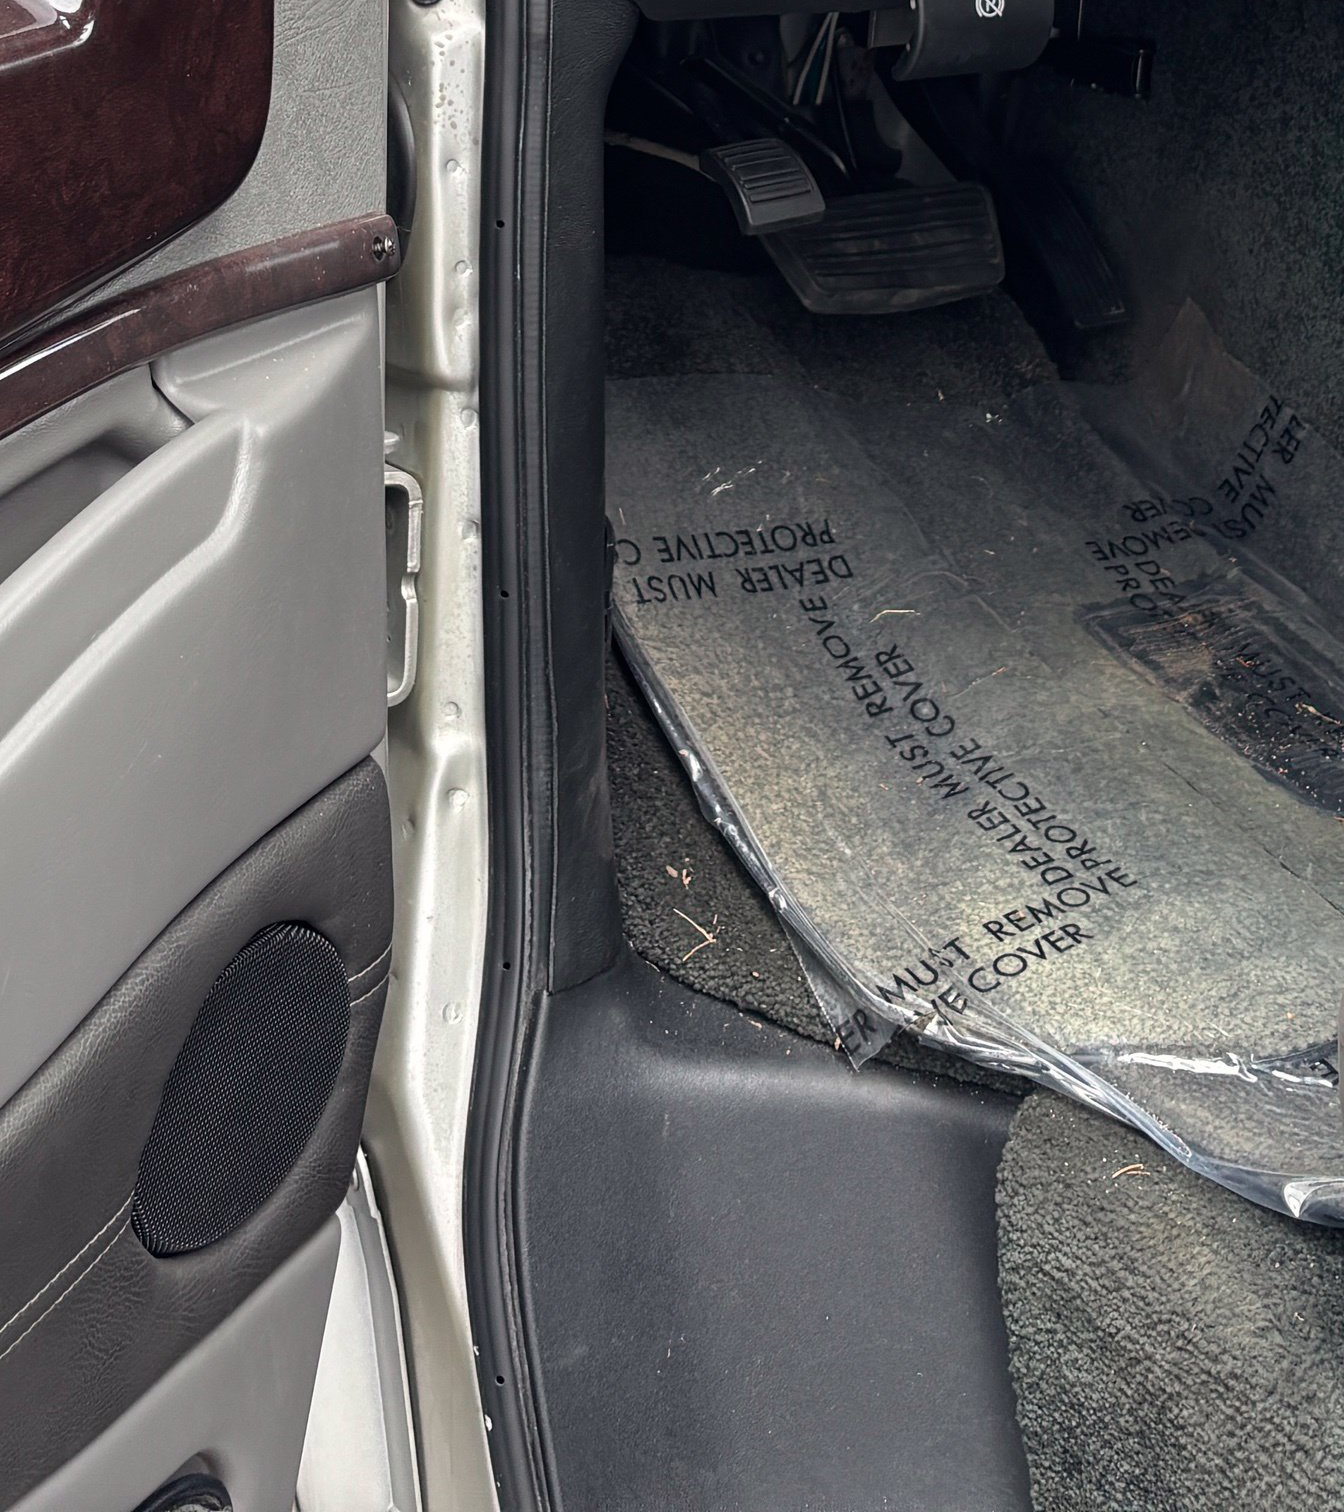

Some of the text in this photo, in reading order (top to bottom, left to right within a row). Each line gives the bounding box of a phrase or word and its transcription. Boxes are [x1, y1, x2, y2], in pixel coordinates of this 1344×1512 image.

[652, 518, 838, 563] PROTECTIVE
[631, 553, 854, 605] DEALER MUST
[799, 595, 1074, 887] DEALER MUST REMOVE
[874, 643, 1112, 872] PROTECTIVE COVER
[982, 866, 1138, 943] REMOVE
[967, 922, 1095, 994] COVER
